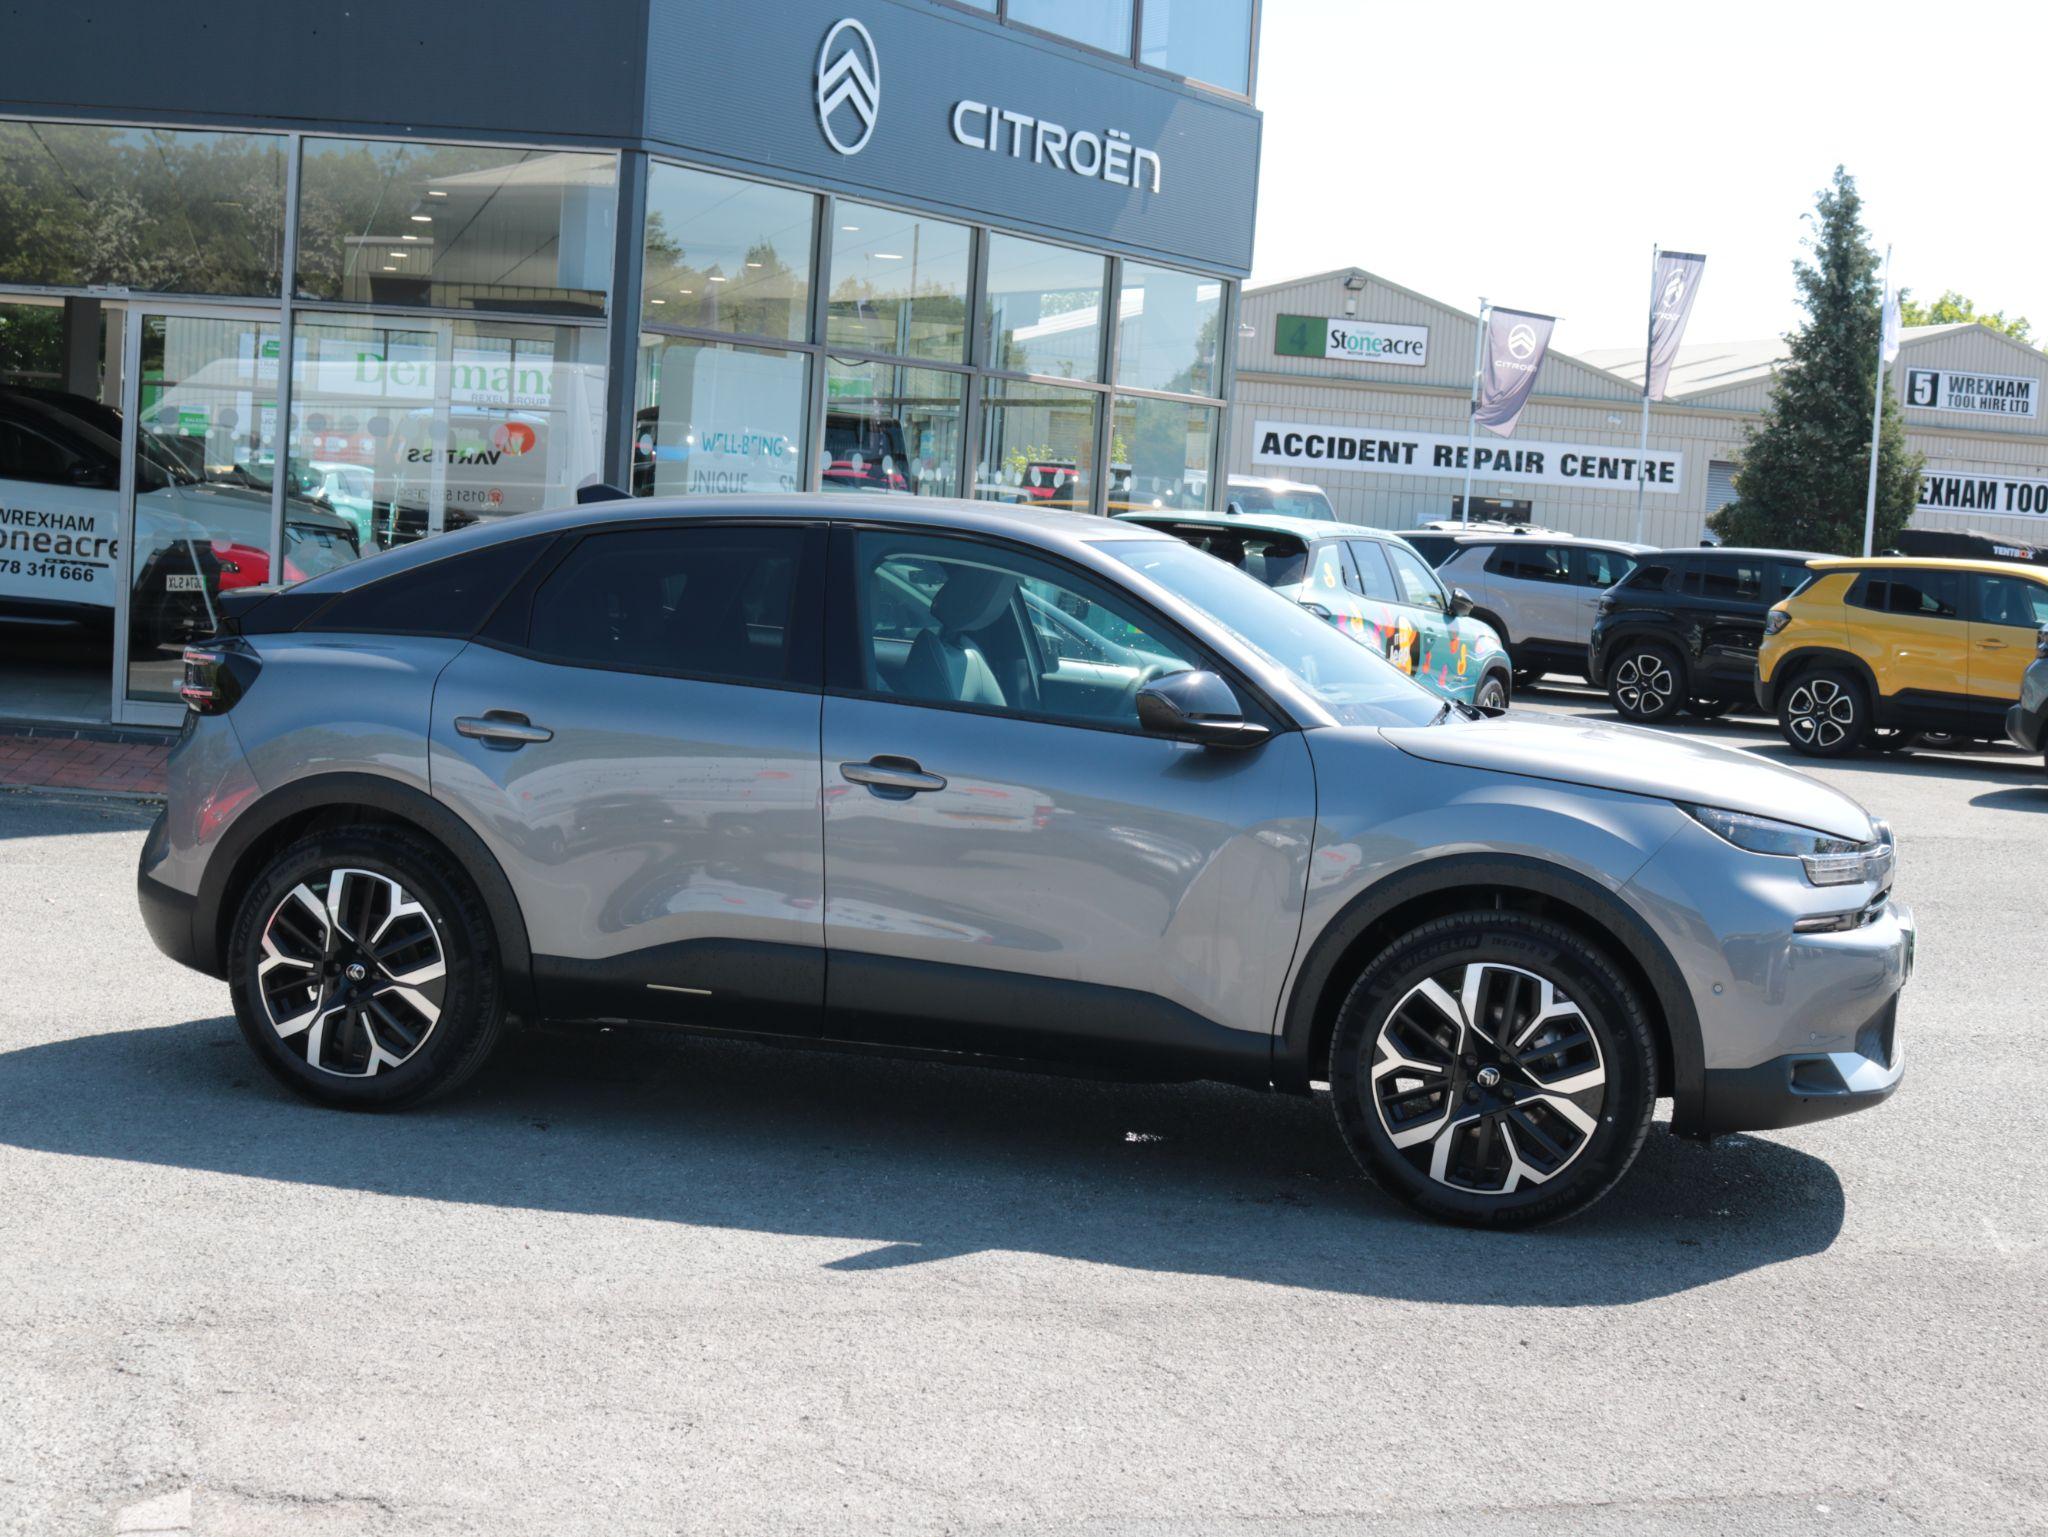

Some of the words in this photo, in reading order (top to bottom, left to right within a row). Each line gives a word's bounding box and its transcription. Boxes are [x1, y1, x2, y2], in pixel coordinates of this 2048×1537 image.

[1331, 329, 1423, 356] Stoneacre
[1914, 373, 1932, 405] 5
[1949, 376, 2029, 399] WREXHAM
[1947, 394, 1976, 409] TOOL
[1979, 397, 2006, 411] HIRE
[2009, 399, 2029, 413] LTD
[1260, 431, 1419, 465] ACCIDENT
[1434, 444, 1544, 473] REPAIR
[1560, 453, 1676, 483] CENTRE
[2004, 483, 2048, 513] TOO
[0, 508, 95, 532] WREXHAM
[27, 562, 56, 578] 311
[60, 566, 94, 582] 666
